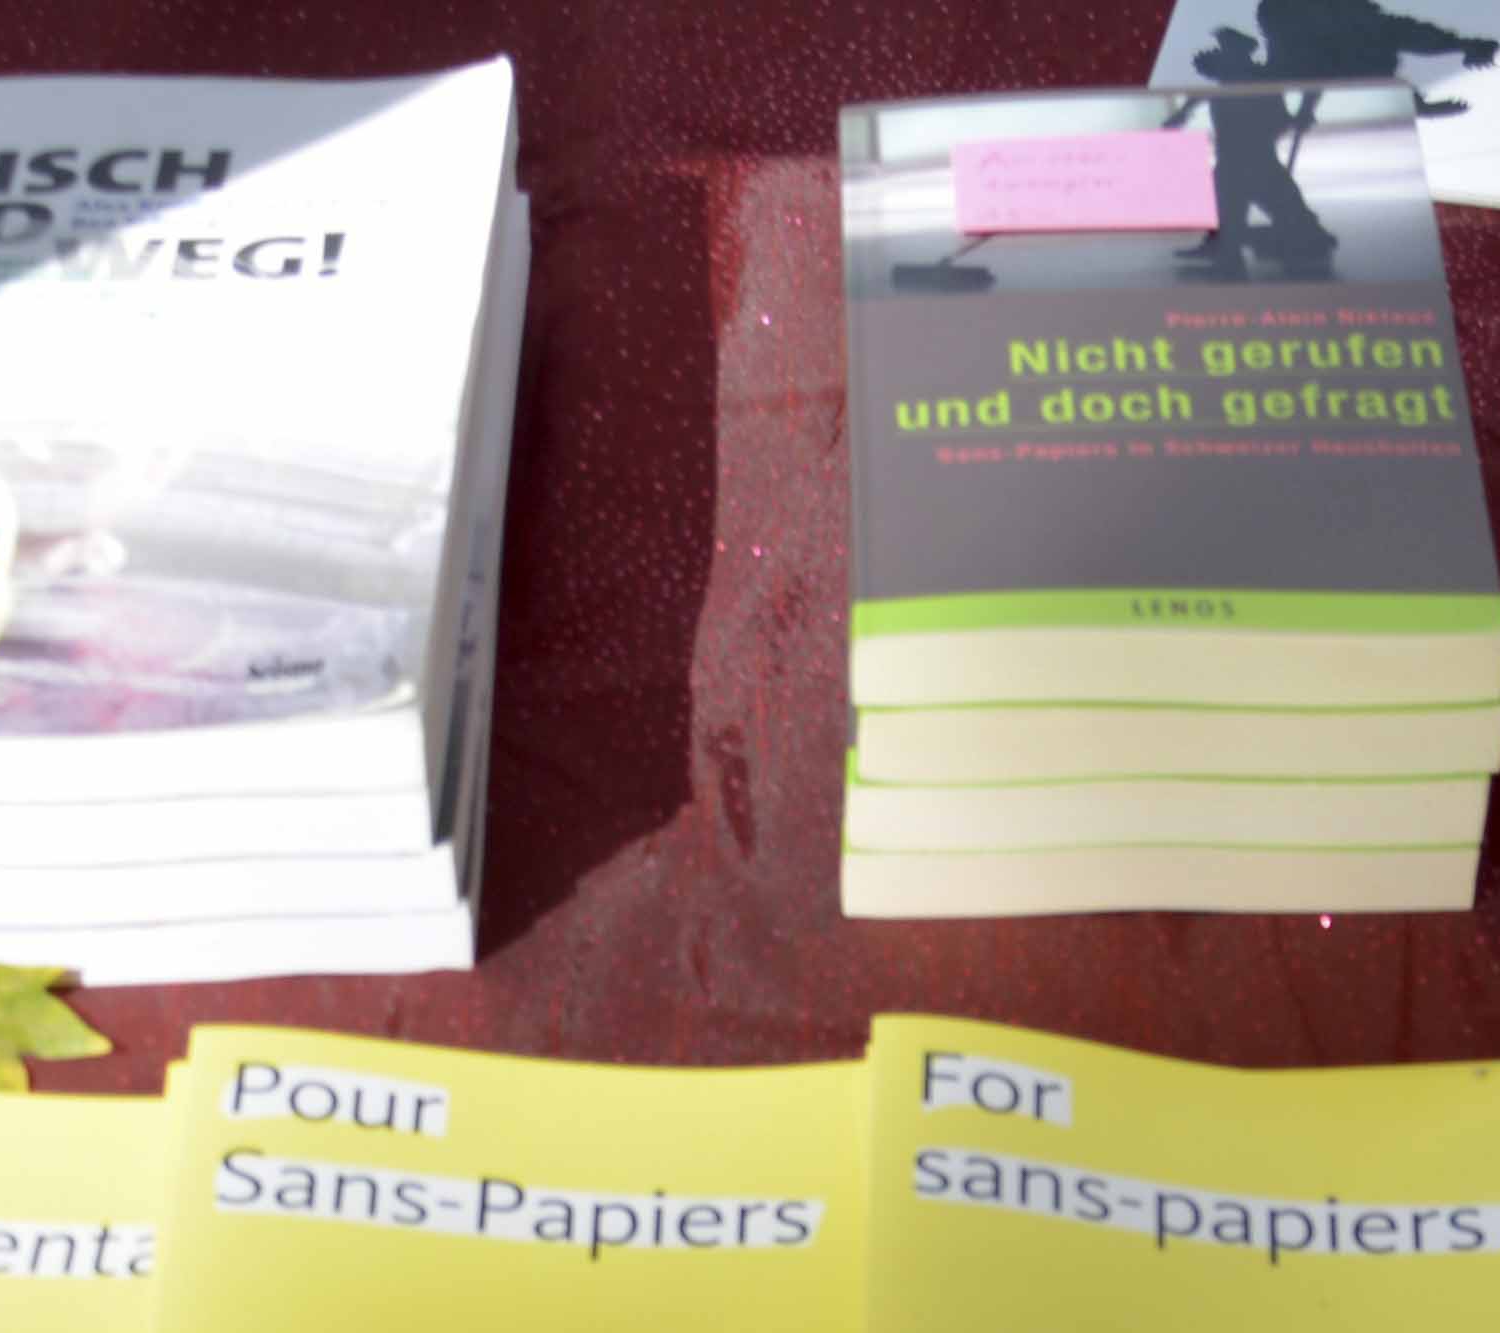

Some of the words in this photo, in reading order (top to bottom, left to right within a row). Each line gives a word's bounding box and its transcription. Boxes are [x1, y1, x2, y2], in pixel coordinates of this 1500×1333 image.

[53, 231, 346, 281] WEG!
[1008, 336, 1176, 376] Nicht
[1202, 333, 1445, 377] gerufen
[894, 390, 1012, 432] und
[1040, 386, 1192, 424] doch
[1223, 382, 1457, 428] gefragt
[231, 1060, 444, 1135] Pour
[920, 1050, 1063, 1123] For
[216, 1146, 813, 1261] Sans-Papiers
[912, 1148, 1487, 1267] sans-papiers
